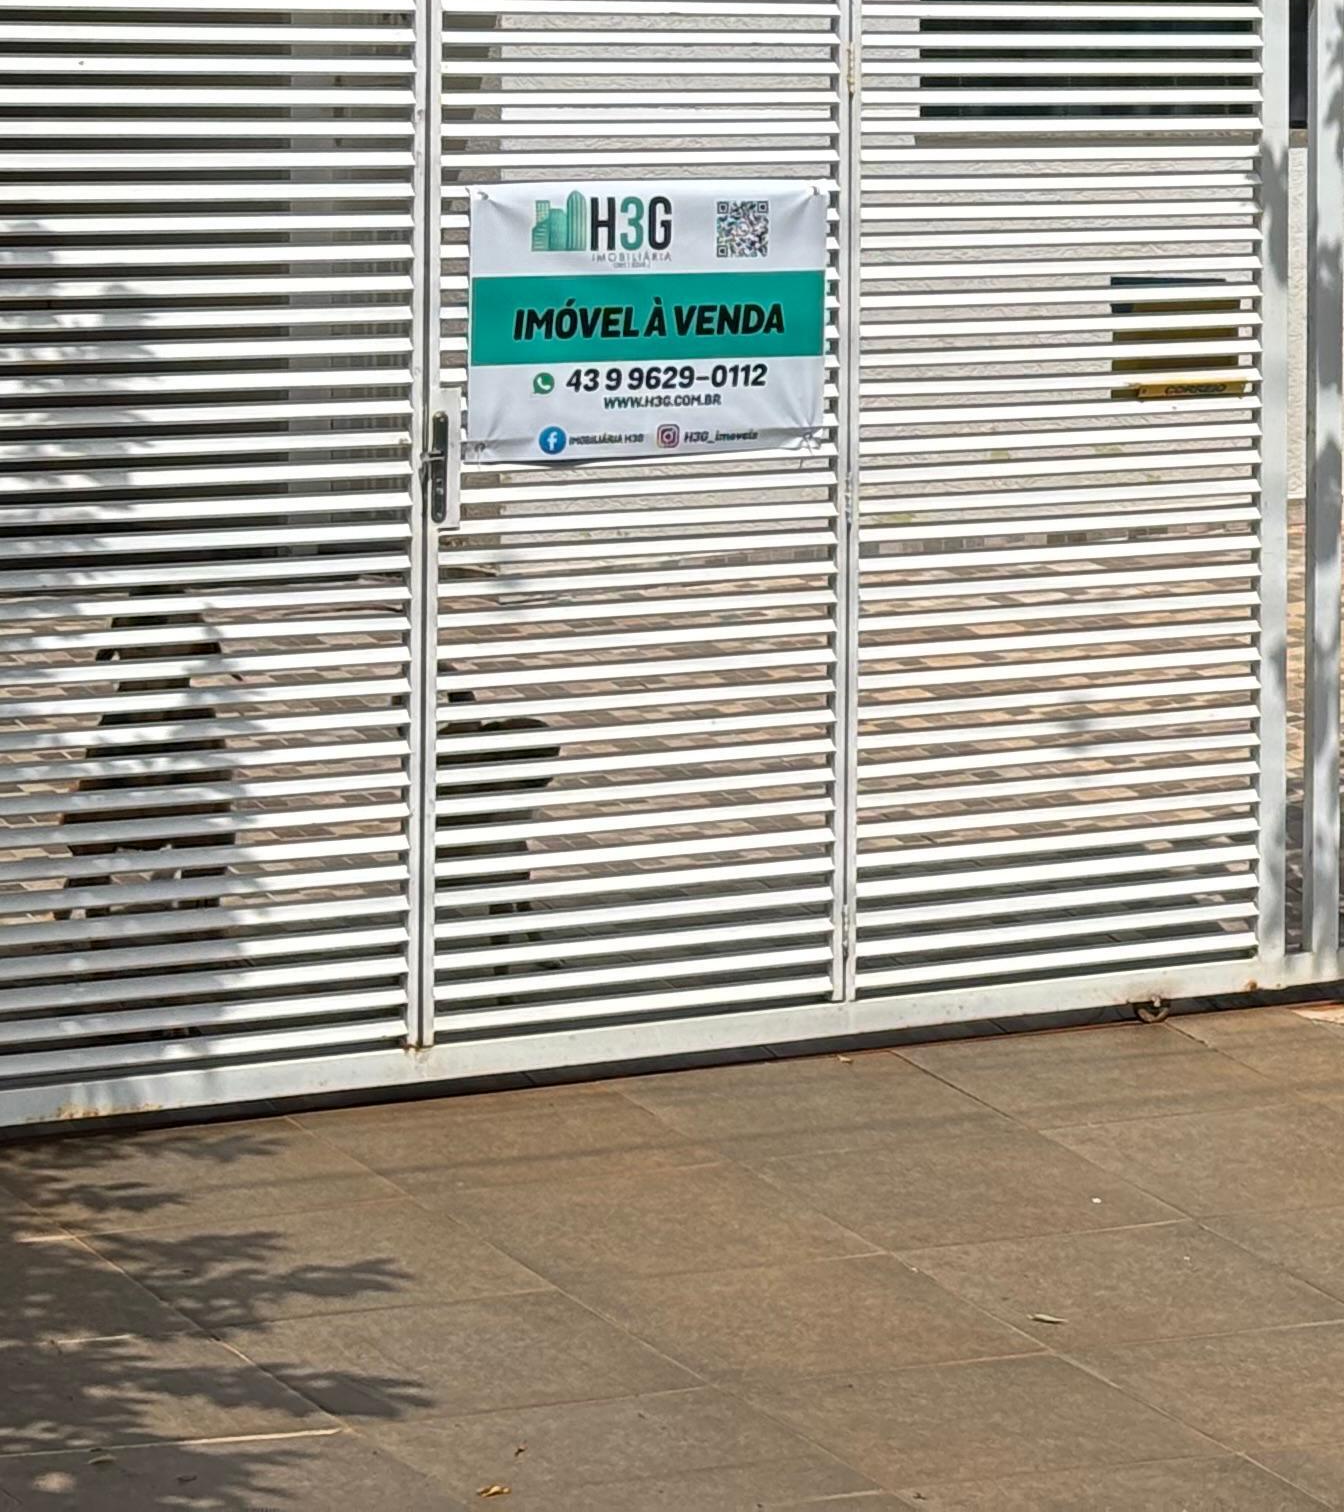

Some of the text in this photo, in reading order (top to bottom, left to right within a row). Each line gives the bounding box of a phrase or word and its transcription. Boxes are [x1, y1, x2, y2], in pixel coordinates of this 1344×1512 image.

[590, 195, 673, 251] H3G
[512, 296, 785, 341] IMÓVEL À VENDA
[566, 363, 768, 392] 43 9 9629-0112
[603, 393, 722, 409] WWW.H3G.COM.BR
